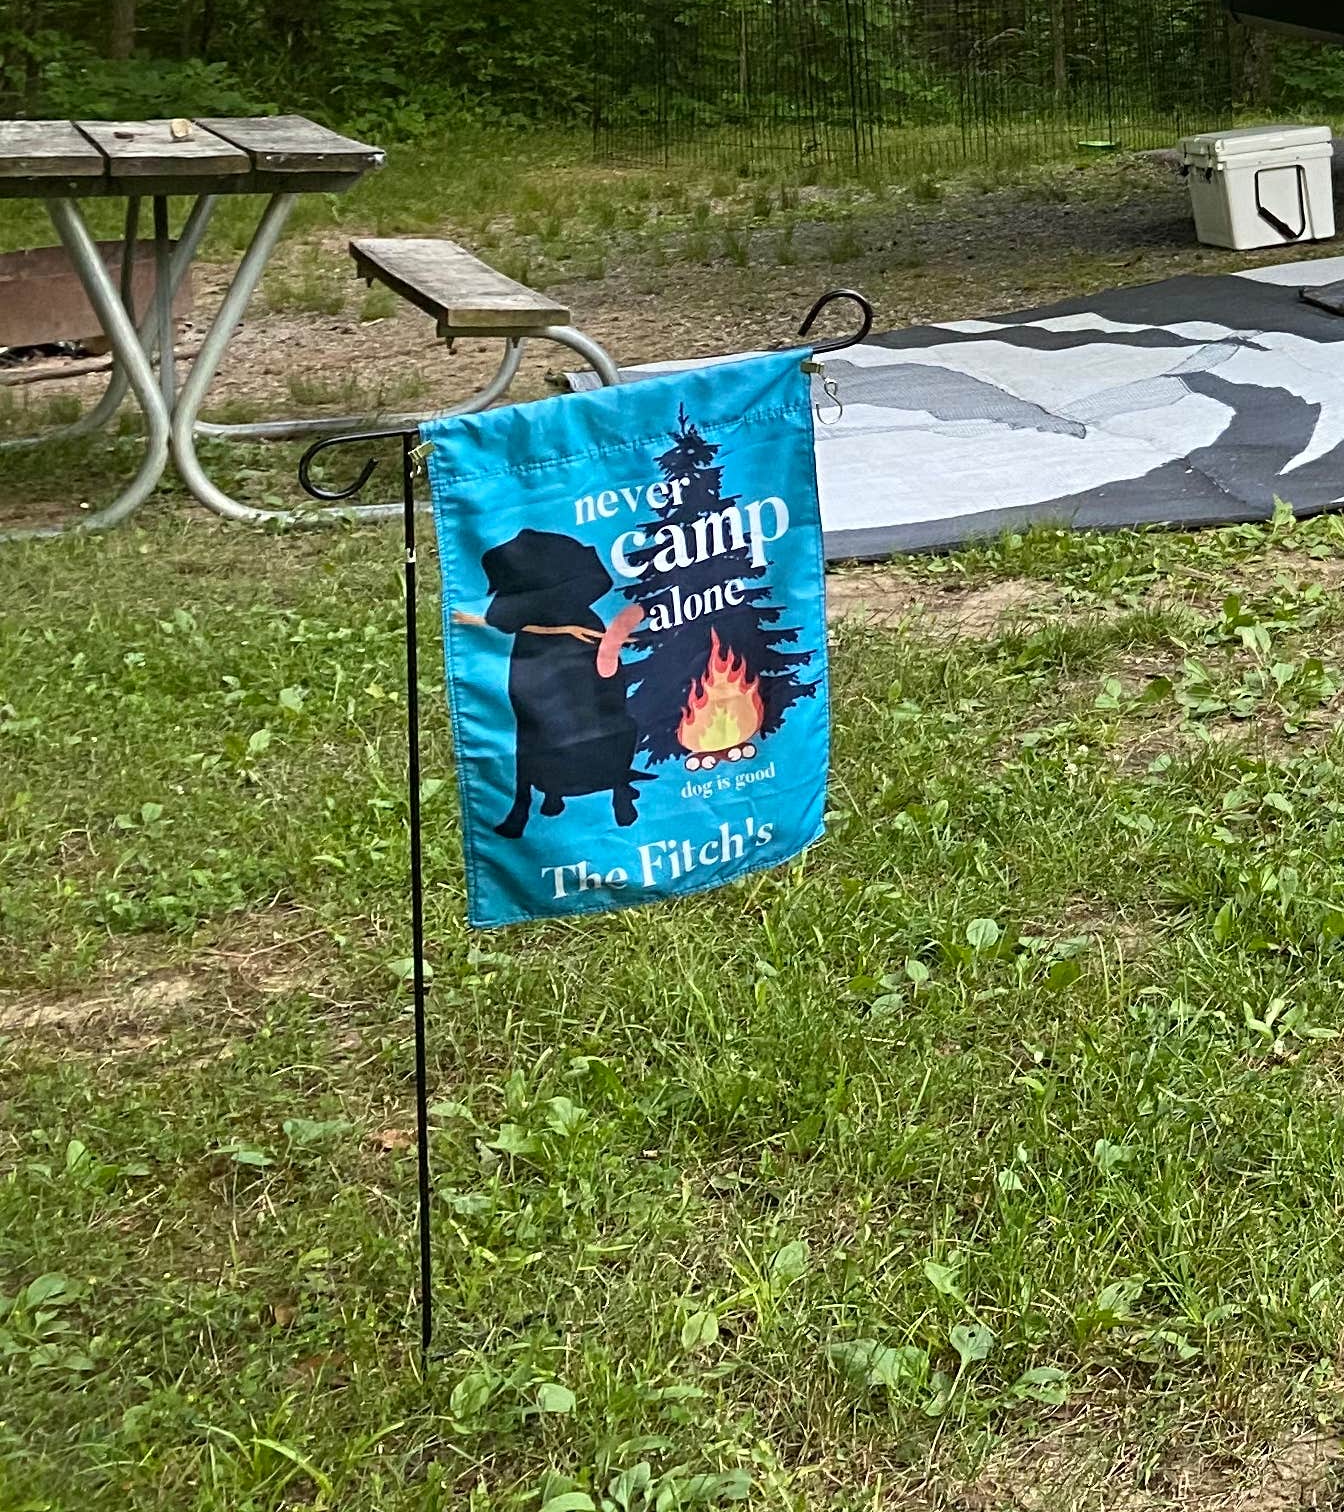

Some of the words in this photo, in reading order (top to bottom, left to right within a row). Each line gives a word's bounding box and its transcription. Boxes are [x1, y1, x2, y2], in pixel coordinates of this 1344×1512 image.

[574, 476, 691, 526] never
[610, 496, 790, 579] camp
[649, 578, 746, 633] alone
[680, 781, 713, 800] dog
[716, 774, 731, 789] is
[734, 761, 777, 788] good
[541, 860, 629, 901] The
[636, 816, 775, 888] Fitch's
